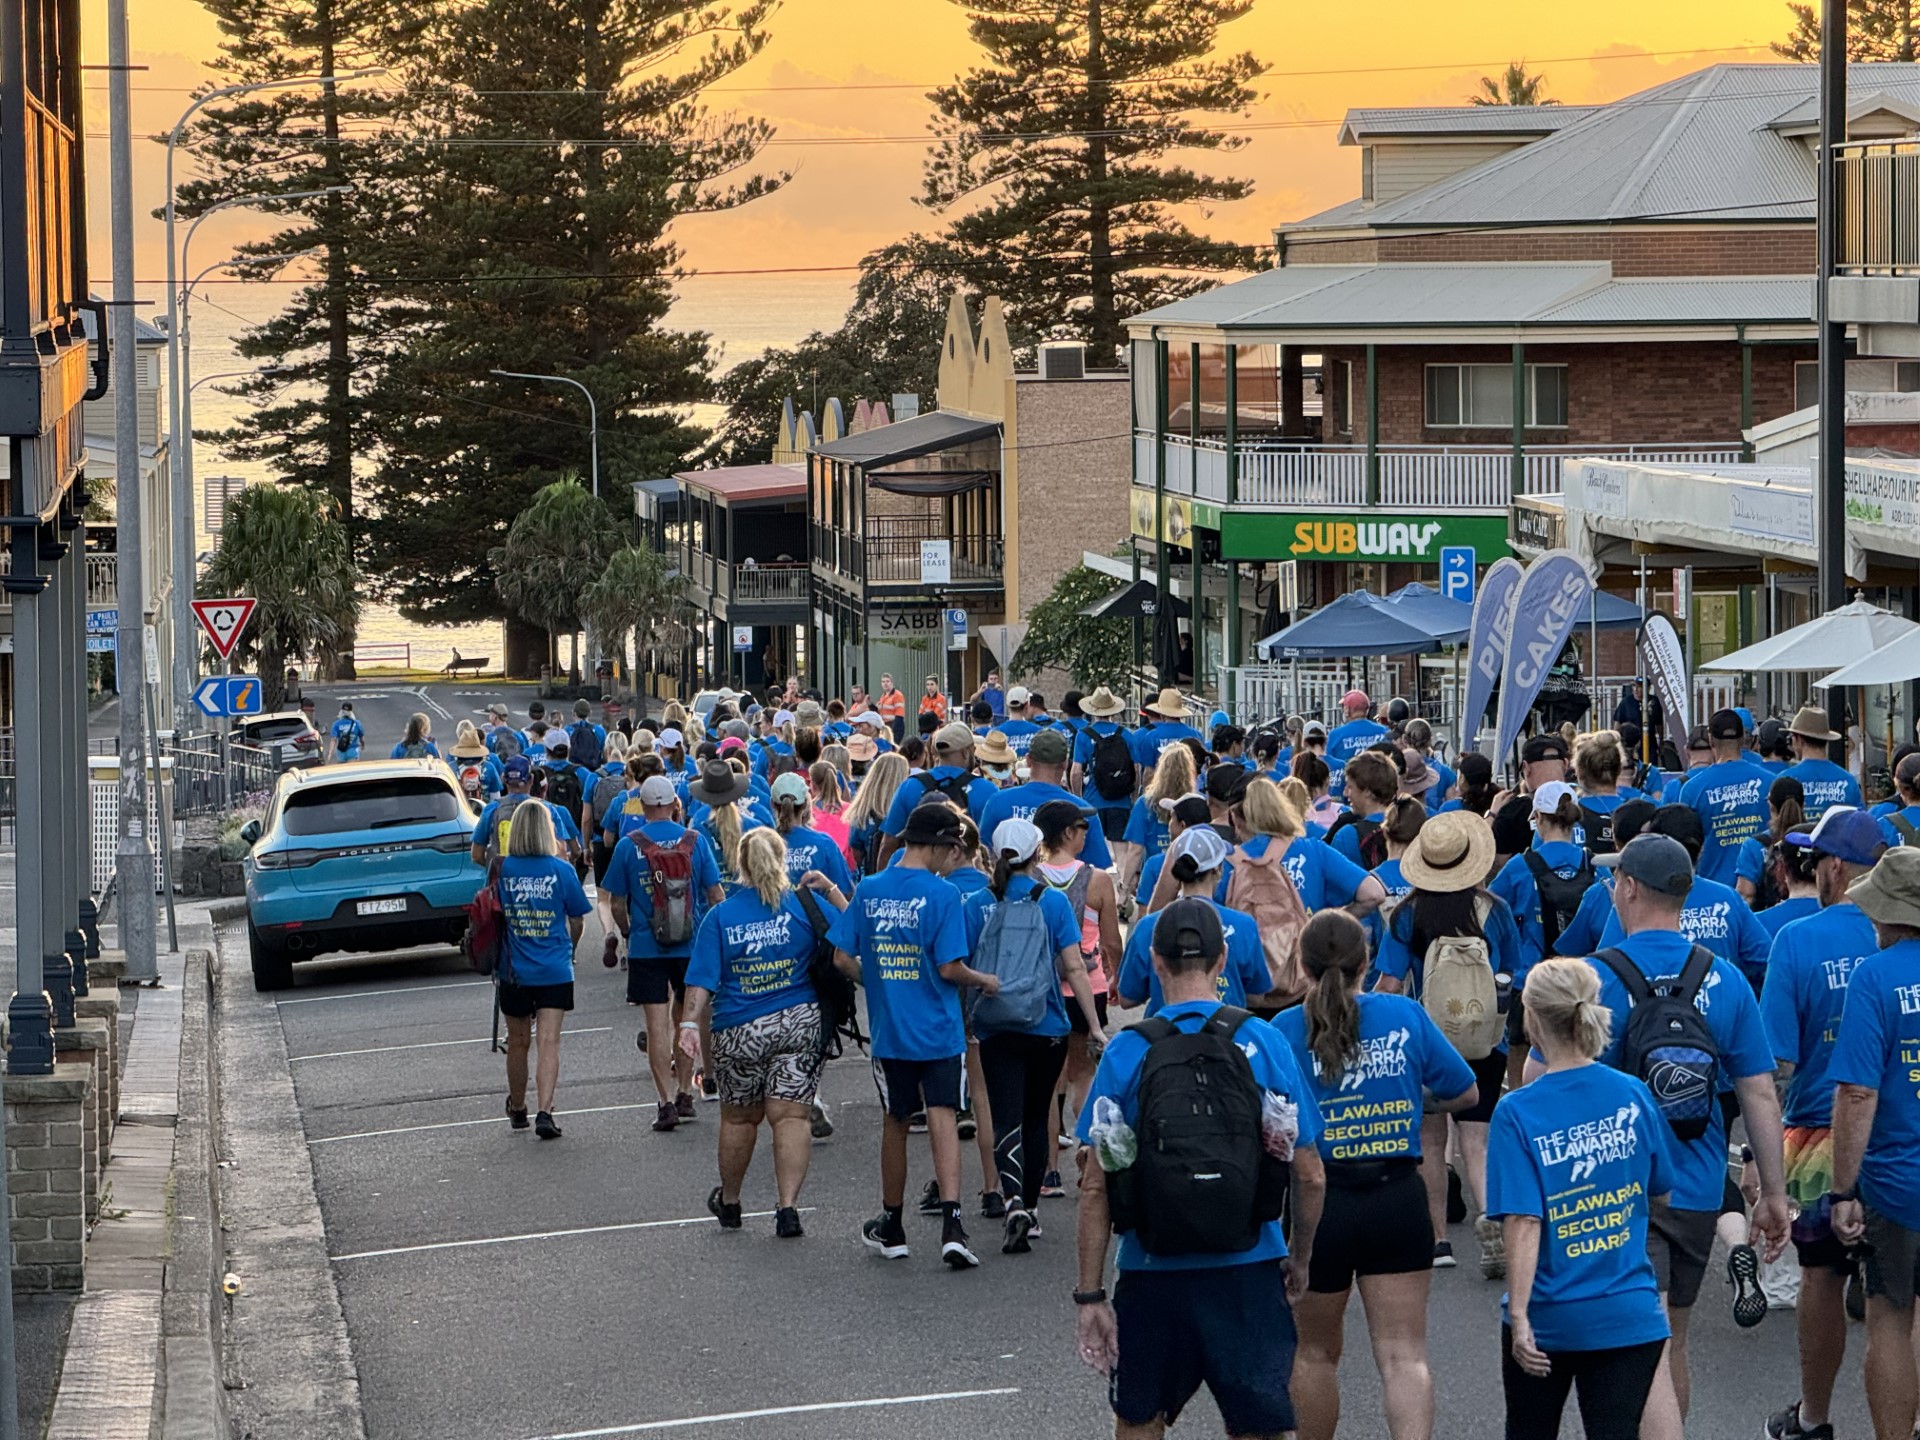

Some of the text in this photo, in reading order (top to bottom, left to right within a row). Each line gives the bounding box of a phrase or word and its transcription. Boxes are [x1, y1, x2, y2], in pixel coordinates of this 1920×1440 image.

[1844, 470, 1920, 503] SHELLHARBOUR NE
[1289, 521, 1442, 555] SUBWAY
[1449, 572, 1469, 598] P
[87, 620, 99, 628] CAN
[881, 612, 943, 630] SABB
[1515, 571, 1585, 688] CAKES
[87, 639, 115, 649] OILET
[1647, 623, 1671, 674] NEWSAGENCY
[1672, 686, 1685, 709] GIFTS
[1658, 631, 1685, 693] SHELLHARBOUR
[1643, 641, 1675, 716] NOW OPEN
[1706, 782, 1750, 797] THE GREAT
[1816, 780, 1837, 788] GREAT
[1708, 790, 1759, 805] ILLAWARRA
[1736, 796, 1759, 805] WALK
[1823, 795, 1846, 803] WALK
[1011, 806, 1028, 815] THE
[1715, 825, 1758, 837] SECURITY
[1719, 836, 1748, 847] GUAR
[340, 845, 413, 856] PORSCHE
[786, 847, 803, 857] EAT
[518, 876, 544, 884] GREAT
[529, 891, 553, 900] WALK
[863, 898, 910, 909] THE GREAT
[725, 920, 776, 934] THE GREAT
[894, 919, 919, 929] WALK
[1679, 916, 1728, 931] WARRA
[728, 926, 790, 945] ILLAWARRA
[1696, 926, 1728, 939] WALK
[763, 936, 791, 948] WALK
[879, 956, 921, 967] CURITY
[1821, 957, 1850, 974] THE
[880, 970, 920, 980] UARDS
[741, 978, 792, 994] GUARDS
[1365, 1063, 1407, 1080] WALK
[1323, 1117, 1413, 1142] SECURITY
[1533, 1116, 1615, 1150] THE GREAT
[1331, 1138, 1410, 1160] GUARDS
[1540, 1126, 1638, 1167] ILLAWARRA
[1597, 1140, 1637, 1166] WALK
[1548, 1181, 1643, 1223] ILLAWARRA
